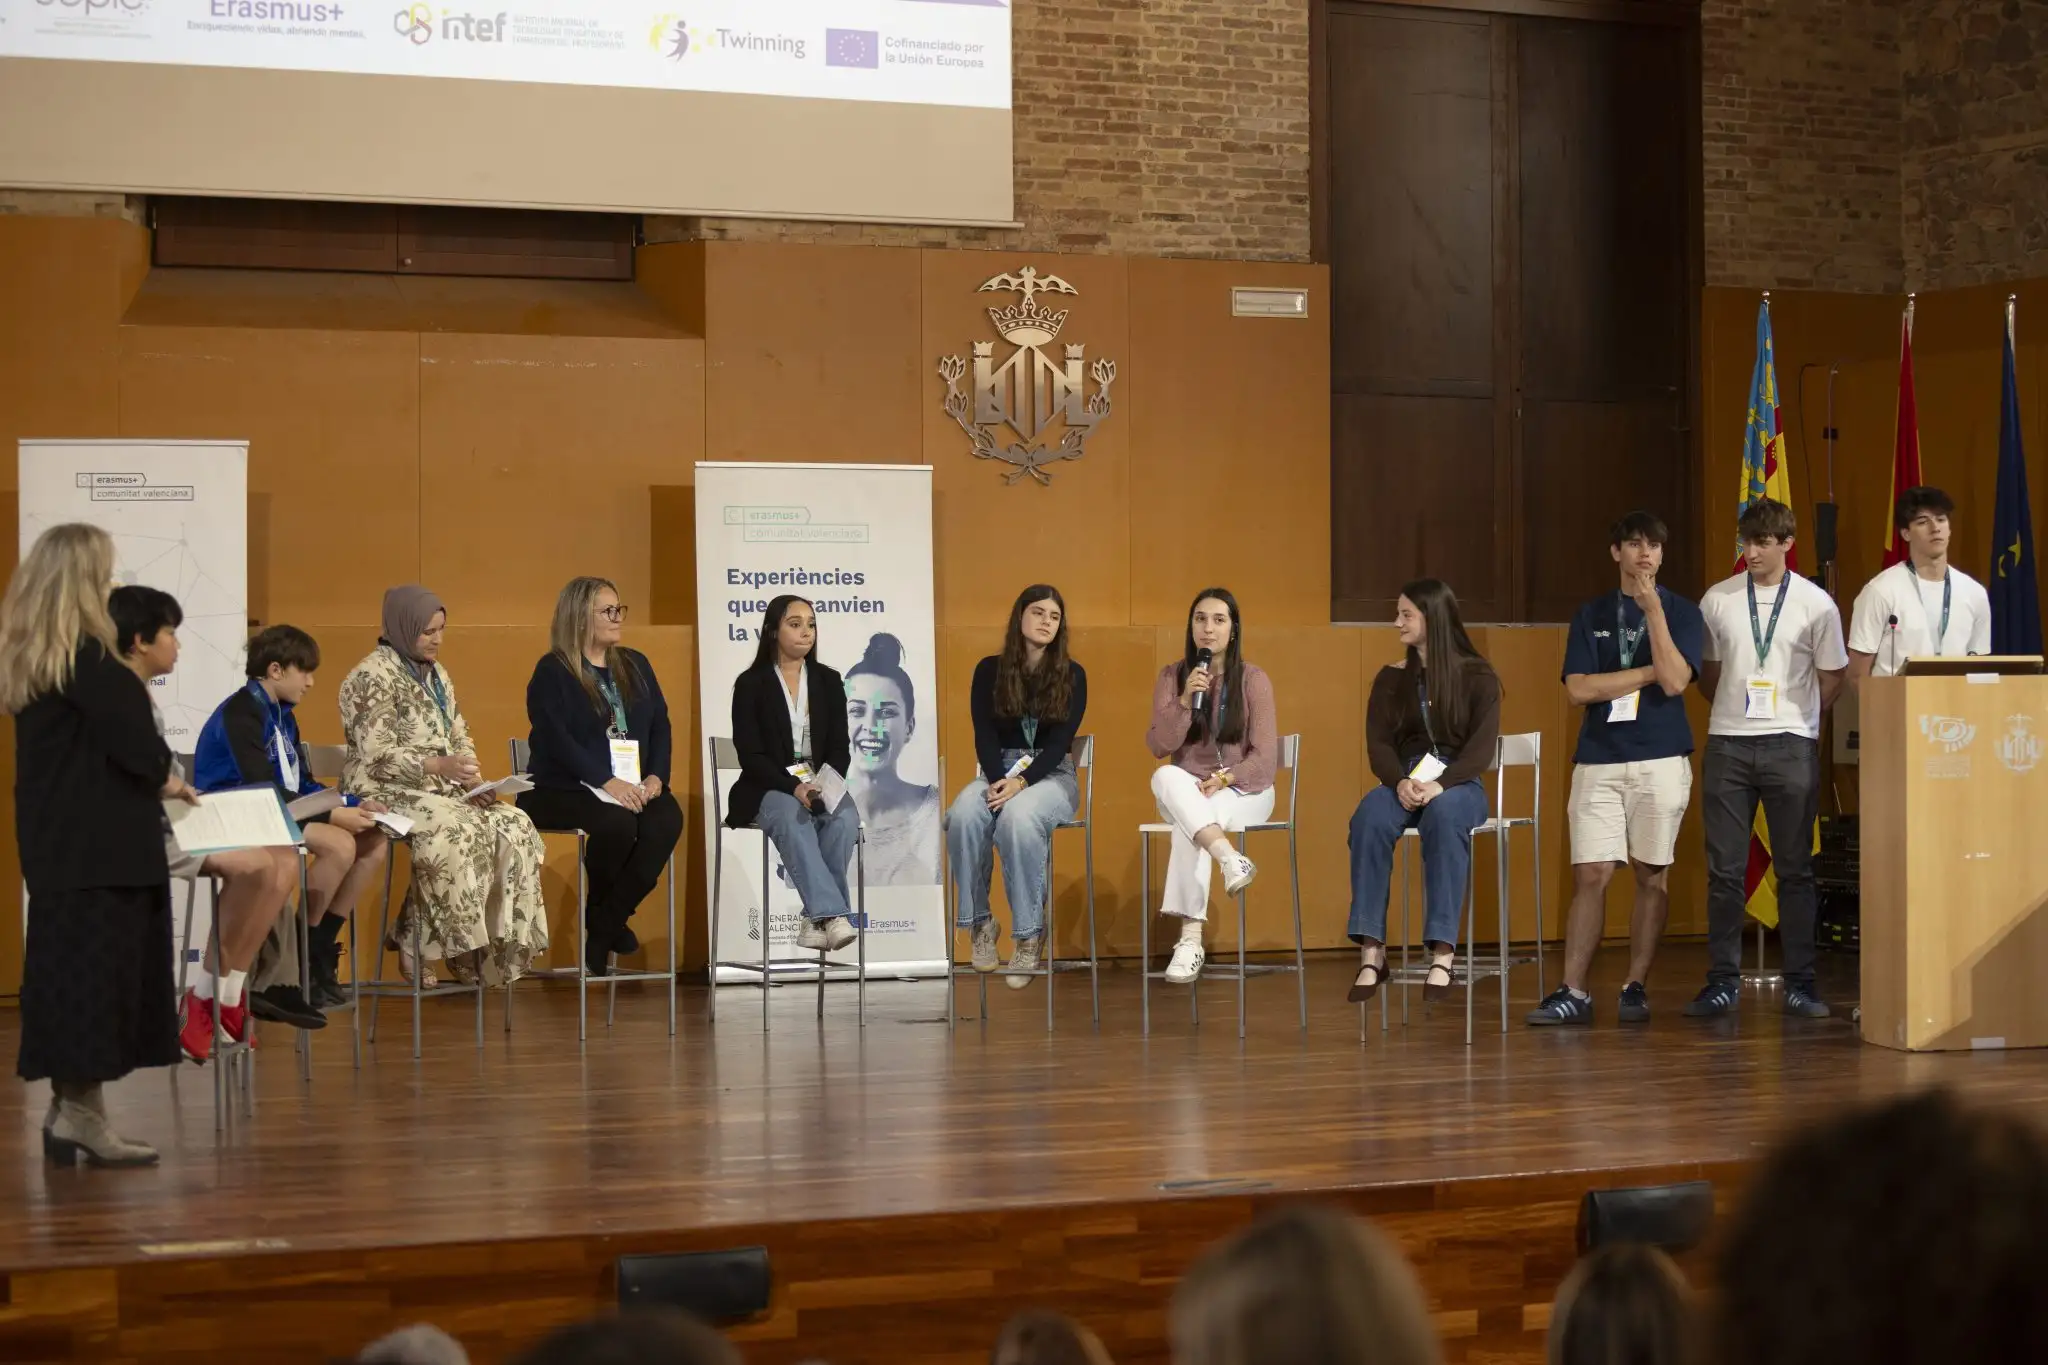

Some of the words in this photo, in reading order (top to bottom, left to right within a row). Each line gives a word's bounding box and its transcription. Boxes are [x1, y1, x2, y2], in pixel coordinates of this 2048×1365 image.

[210, 0, 344, 22] Erasmus+
[885, 36, 961, 52] Cofinanciado
[963, 42, 985, 55] por
[885, 51, 896, 63] la
[899, 52, 934, 65] Unión
[936, 55, 985, 69] Europea
[96, 476, 139, 484] erasmus+
[97, 489, 141, 498] comunitat
[143, 489, 189, 498] valenciana
[749, 511, 800, 520] erasmus+
[750, 527, 803, 539] comunitat
[808, 528, 863, 539] valenciana
[727, 567, 866, 589] Experiències
[728, 599, 768, 618] que
[728, 623, 749, 642] la
[769, 914, 803, 923] ENERAL
[870, 919, 917, 929] Erasmus+
[769, 924, 801, 933] ALENCI
